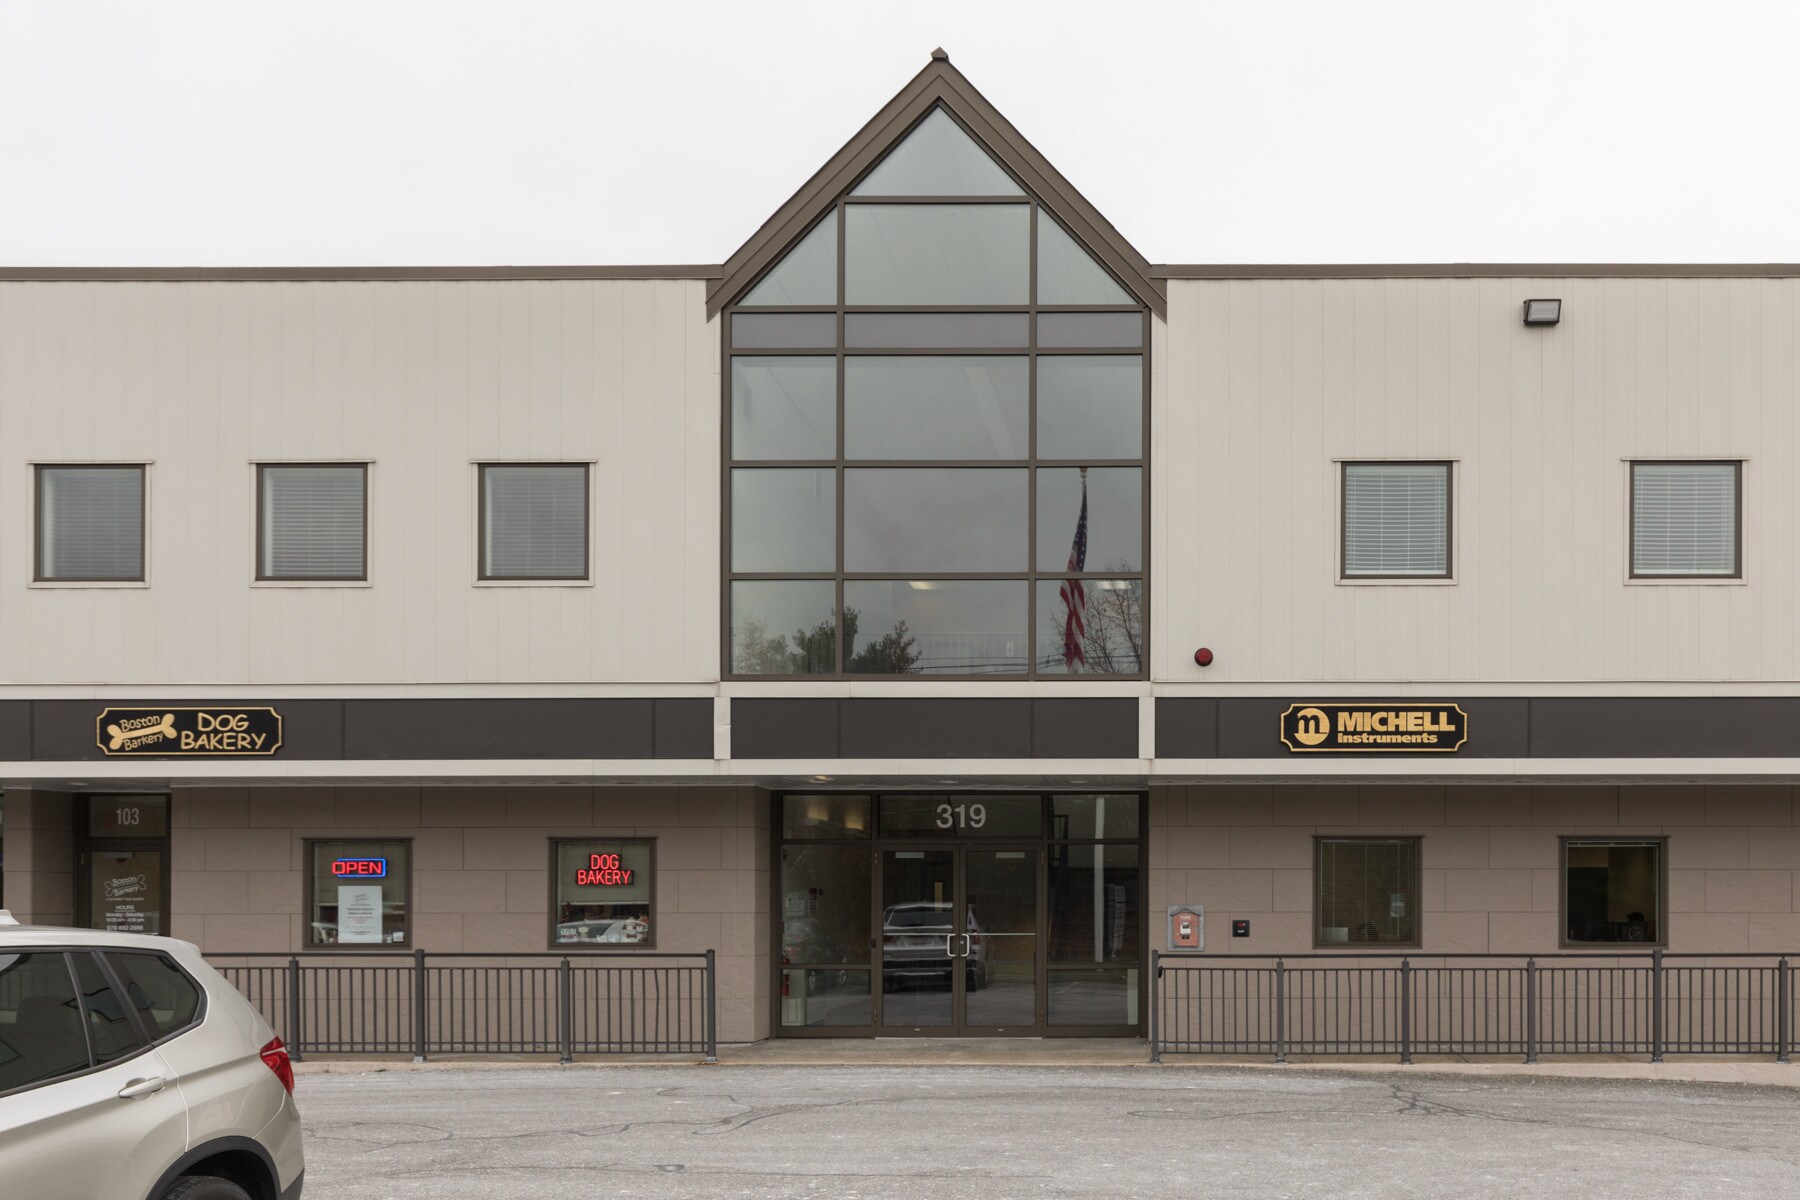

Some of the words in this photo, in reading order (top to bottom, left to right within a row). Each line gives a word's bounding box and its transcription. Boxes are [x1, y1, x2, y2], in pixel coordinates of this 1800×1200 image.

[119, 715, 161, 732] Boston
[197, 712, 249, 731] DOG
[1337, 711, 1456, 732] MICHELL
[122, 732, 164, 751] Barkery
[180, 730, 267, 750] BAKERY
[1337, 732, 1438, 743] Instruments
[116, 808, 140, 825] 103
[936, 804, 987, 828] 319
[331, 861, 382, 875] OPEN
[590, 854, 619, 870] DOG
[577, 869, 631, 885] BAKERY
